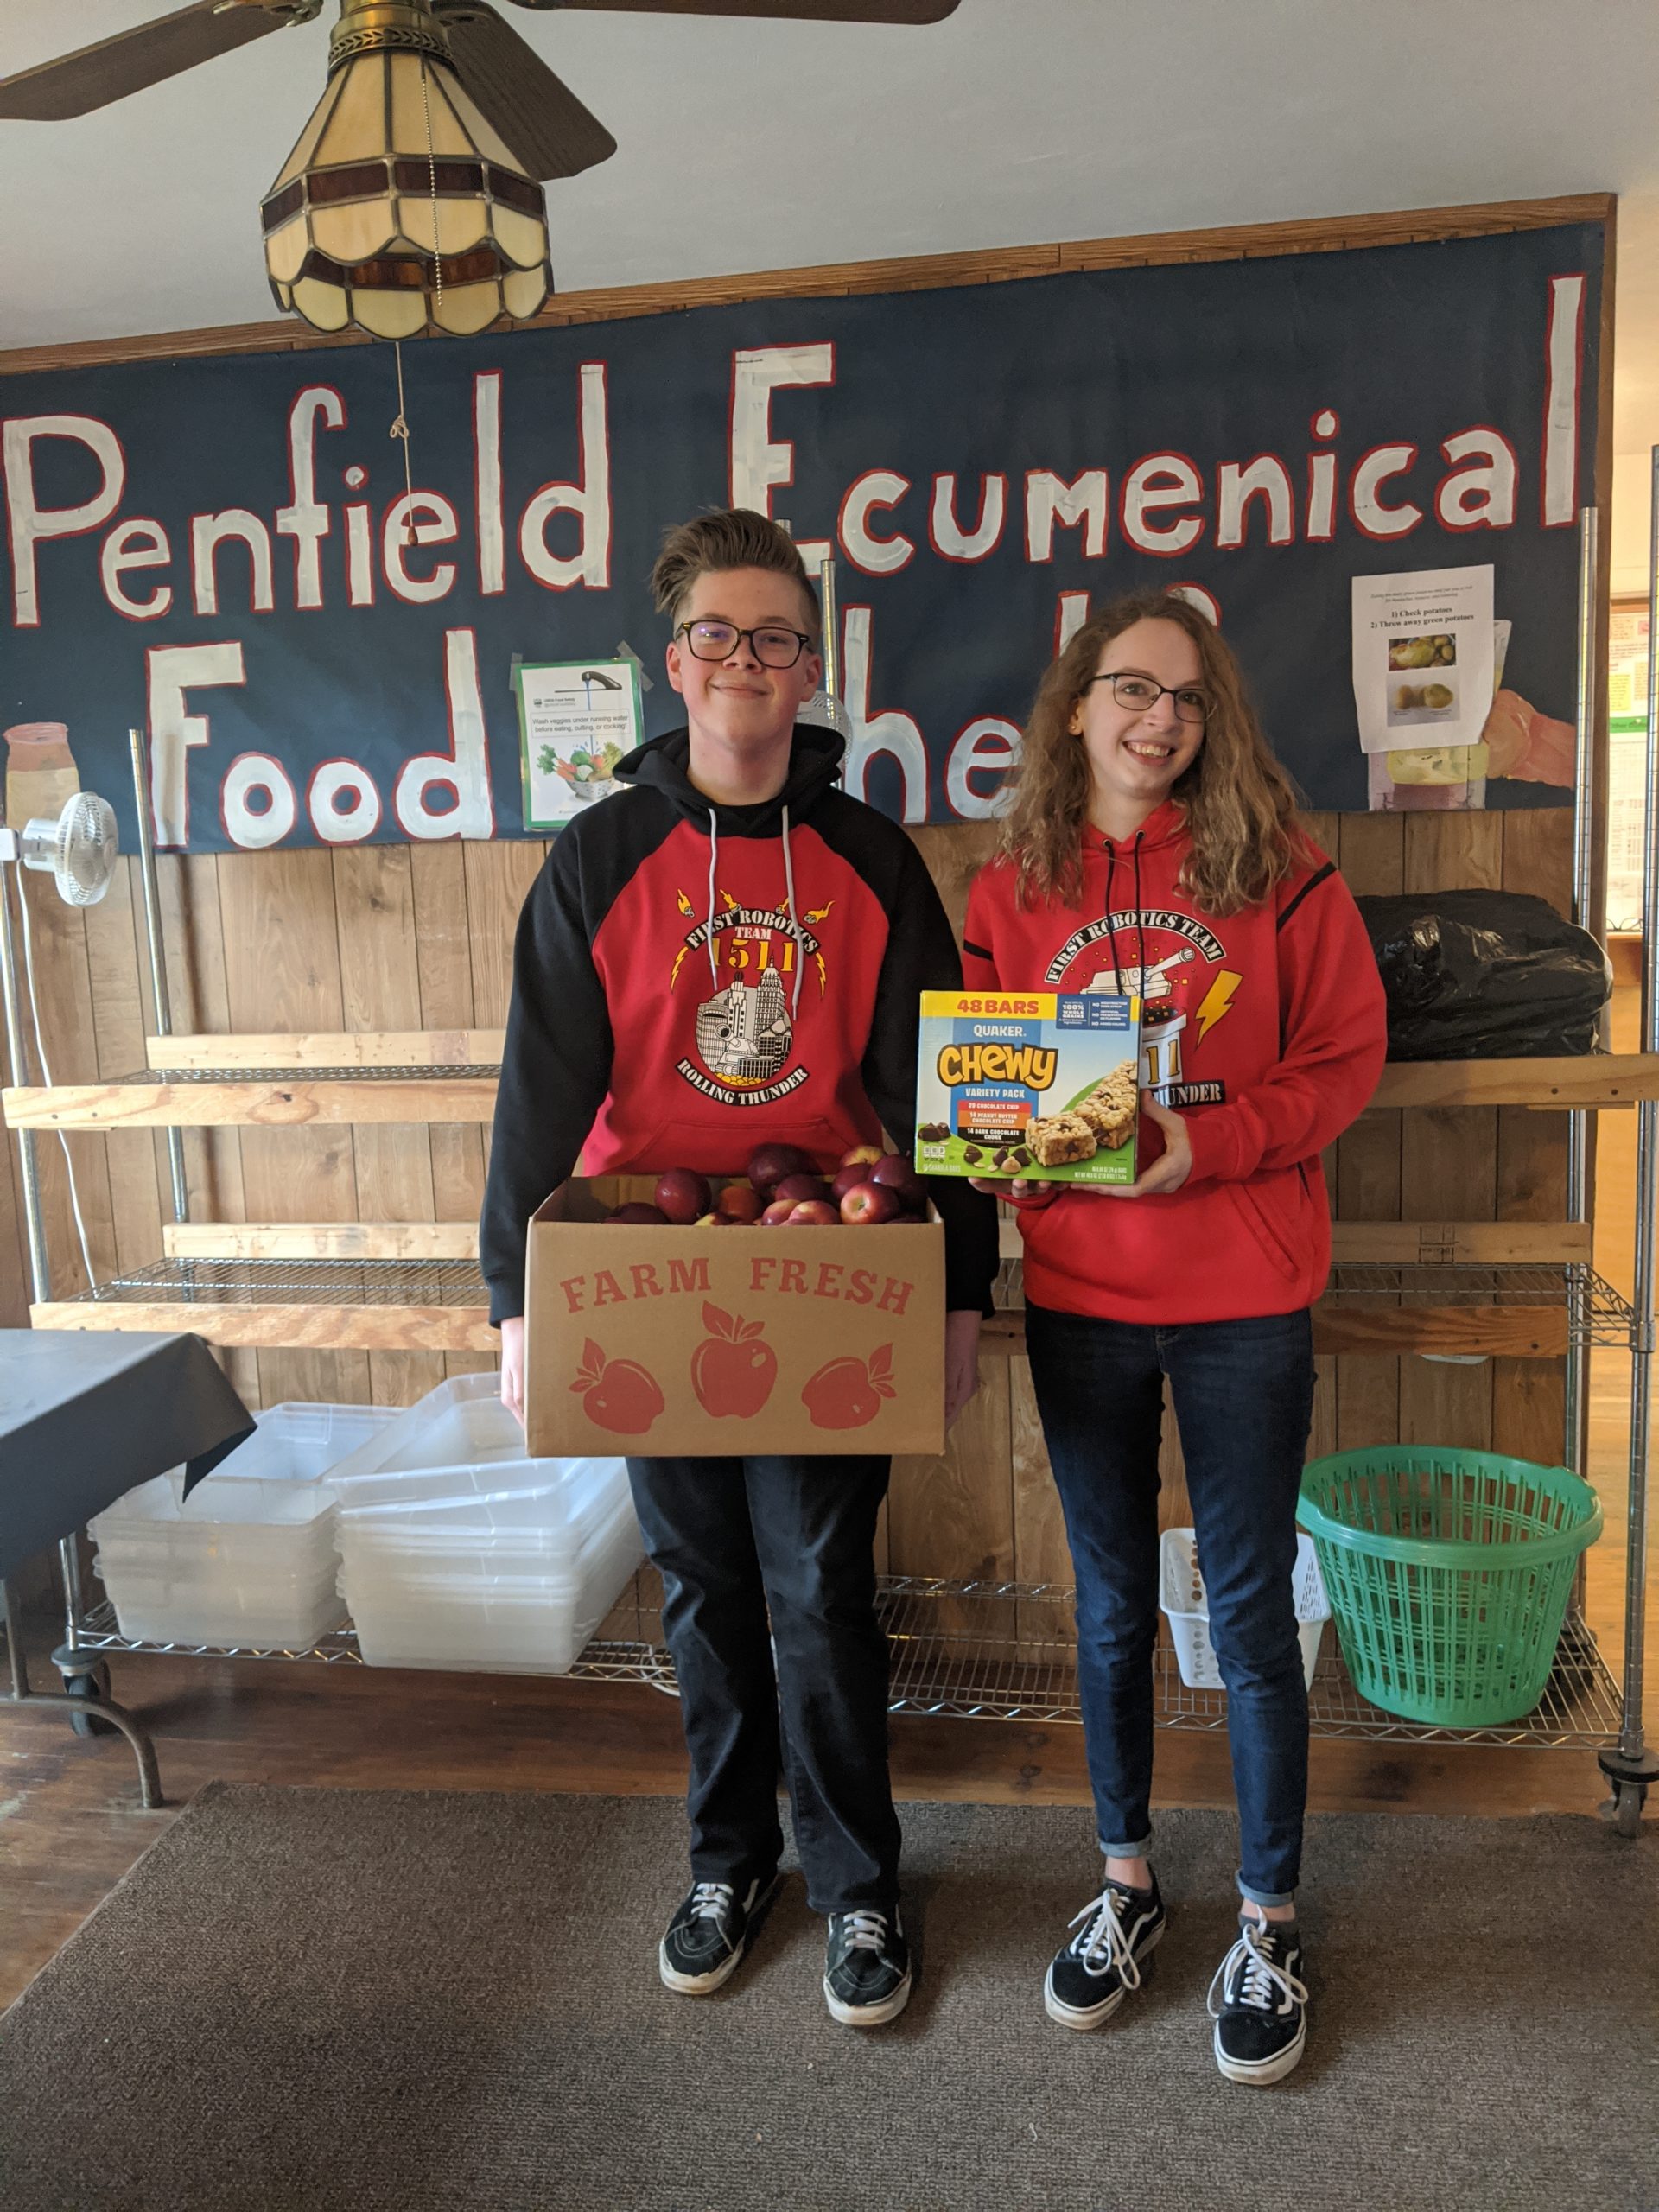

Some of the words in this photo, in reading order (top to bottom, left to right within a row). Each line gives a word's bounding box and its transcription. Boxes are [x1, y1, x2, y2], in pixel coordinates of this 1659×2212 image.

[2, 360, 612, 627] Penfield
[728, 272, 1586, 579] Ecumenical
[1399, 608, 1422, 618] Check
[1423, 607, 1452, 617] potatoes
[1380, 620, 1402, 628] Throw
[1403, 619, 1421, 627] away
[1423, 617, 1443, 626] green
[1445, 614, 1474, 625] potatoes
[550, 717, 571, 726] veggies
[590, 715, 612, 724] running
[144, 626, 497, 849] Food
[734, 926, 772, 940] TEAM
[1047, 932, 1086, 982] FIRST
[1087, 912, 1179, 939] ROBOTICS
[1179, 918, 1222, 959] TEAM
[709, 938, 794, 972] 1511
[957, 999, 982, 1013] 48
[984, 999, 1039, 1014] BARS
[973, 1024, 1025, 1037] QUAKER
[677, 1059, 734, 1103] ROLLING
[738, 1068, 808, 1105] THUNDER
[965, 1088, 1001, 1097] VARIETY
[1002, 1089, 1026, 1098] PACK
[560, 1257, 711, 1313] FARM
[749, 1257, 914, 1315] FRESH
